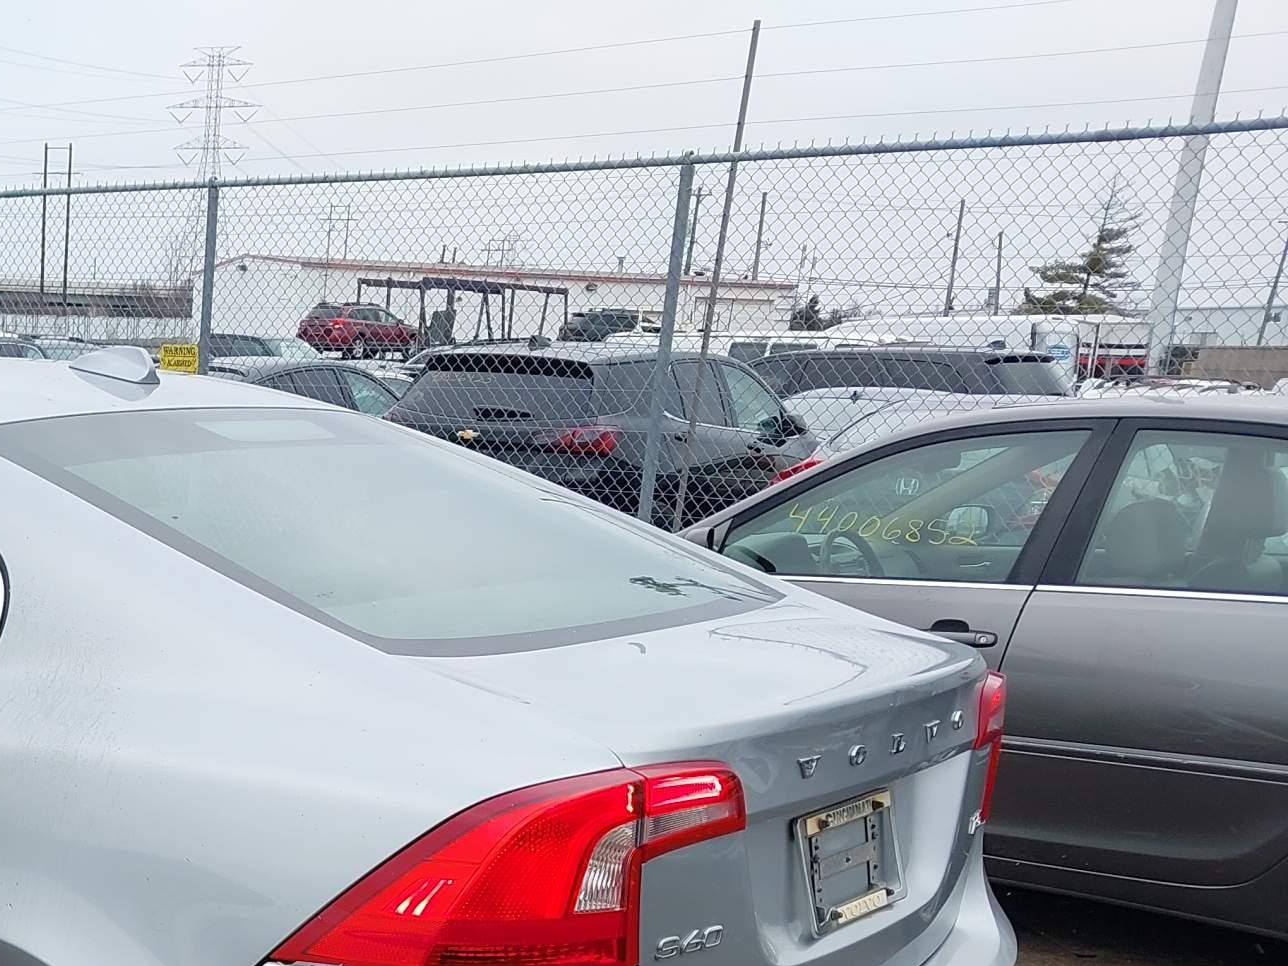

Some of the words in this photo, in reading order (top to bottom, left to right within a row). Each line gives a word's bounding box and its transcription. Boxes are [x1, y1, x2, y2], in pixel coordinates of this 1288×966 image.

[163, 346, 196, 356] WARNING
[789, 503, 978, 546] 44006852
[797, 710, 965, 780] VOLVO
[654, 924, 724, 960] S60
